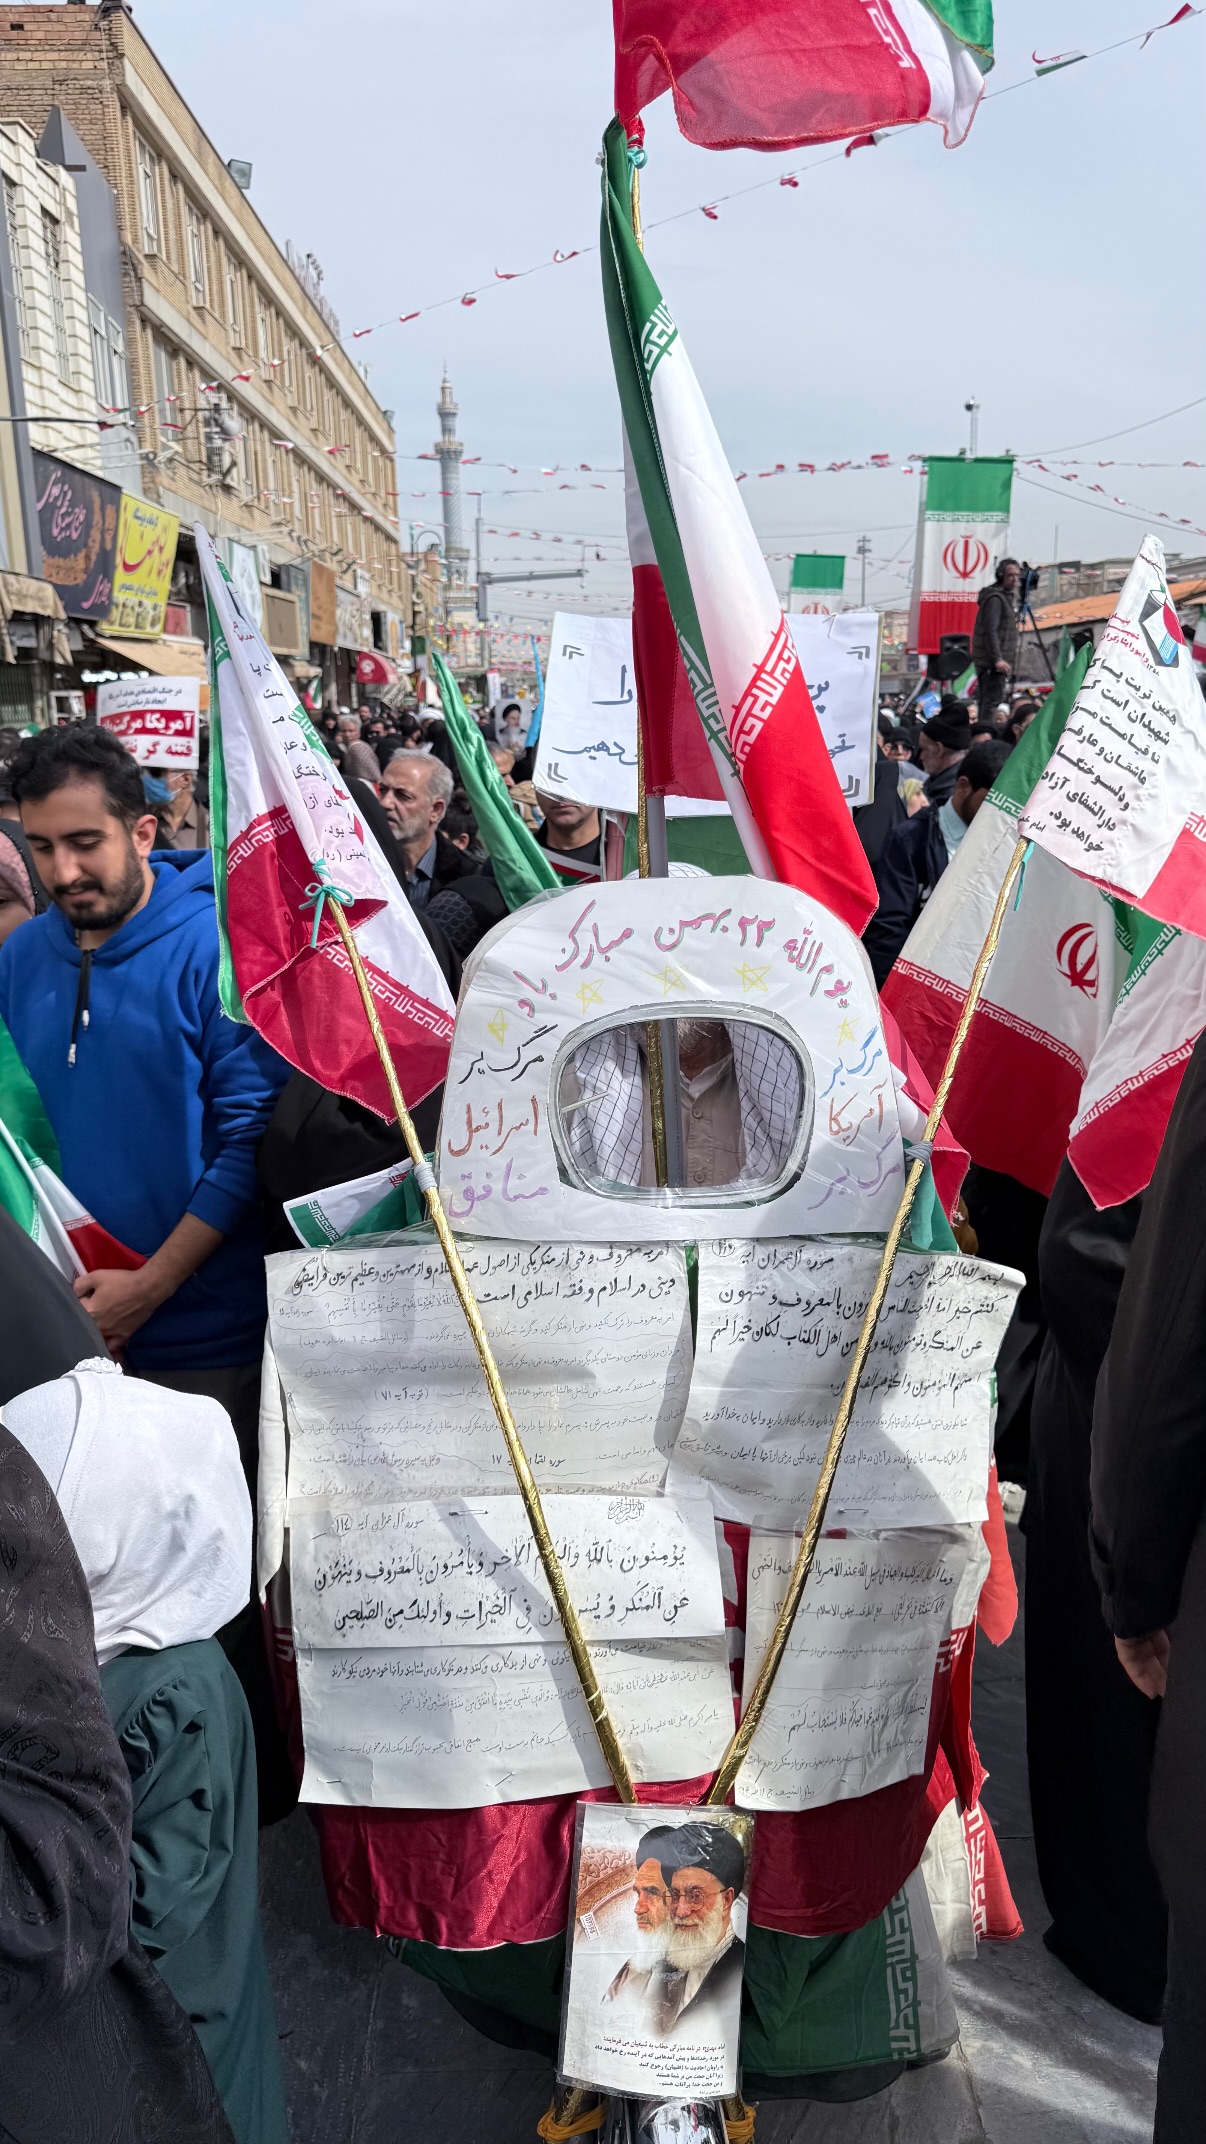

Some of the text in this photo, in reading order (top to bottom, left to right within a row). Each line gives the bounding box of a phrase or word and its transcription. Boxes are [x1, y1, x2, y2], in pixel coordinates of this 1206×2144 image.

[1125, 676, 1154, 700] تربت
[145, 711, 195, 735] آمریکا
[1101, 687, 1170, 746] شهیدان است
[1152, 700, 1177, 726] همین
[142, 741, 160, 760] گر
[165, 741, 193, 757] فتنه
[1100, 715, 1151, 757] قیامت
[1095, 746, 1147, 786] عاشقان و
[1066, 791, 1117, 831] دارالشفای
[1119, 801, 1130, 812] و
[1071, 826, 1105, 853] خواهد
[555, 900, 635, 972] مبارک
[654, 907, 733, 953] بهمن
[738, 914, 776, 948] ۲۲
[458, 1024, 558, 1084] مرگ بر
[819, 1057, 845, 1099] بر
[447, 1094, 540, 1158] اسرائیل
[827, 1079, 888, 1147] آمریکا
[448, 1158, 550, 1219] منافق
[414, 1262, 424, 1277] از
[508, 1252, 520, 1273] از
[534, 1245, 556, 1274] منکر
[556, 1247, 570, 1268] از
[329, 1266, 352, 1287] ترین
[351, 1259, 375, 1293] عظیم
[562, 1279, 583, 1299] فقه
[631, 1282, 647, 1299] در
[476, 1284, 516, 1304] است
[516, 1280, 560, 1309] اسلامی
[584, 1287, 595, 1303] و
[597, 1275, 632, 1308] اسلام
